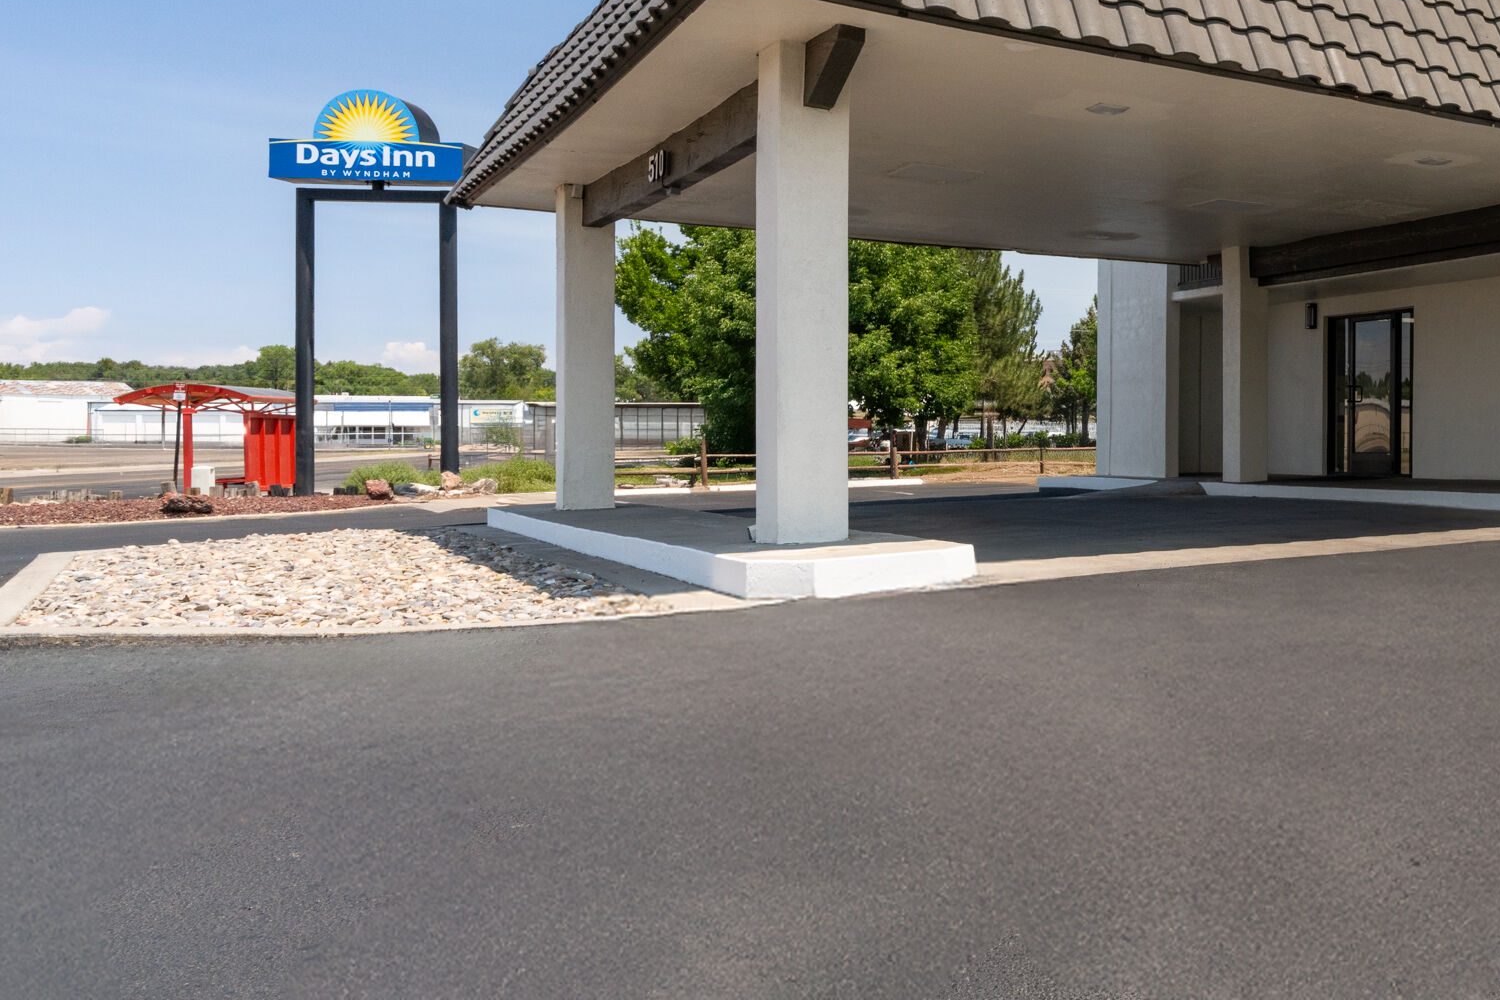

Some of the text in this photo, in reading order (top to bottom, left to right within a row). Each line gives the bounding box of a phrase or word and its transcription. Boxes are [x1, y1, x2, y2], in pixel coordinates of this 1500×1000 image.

[296, 143, 436, 169] Days Inn
[647, 149, 664, 183] 510
[321, 169, 411, 178] BY WYNDHAM
